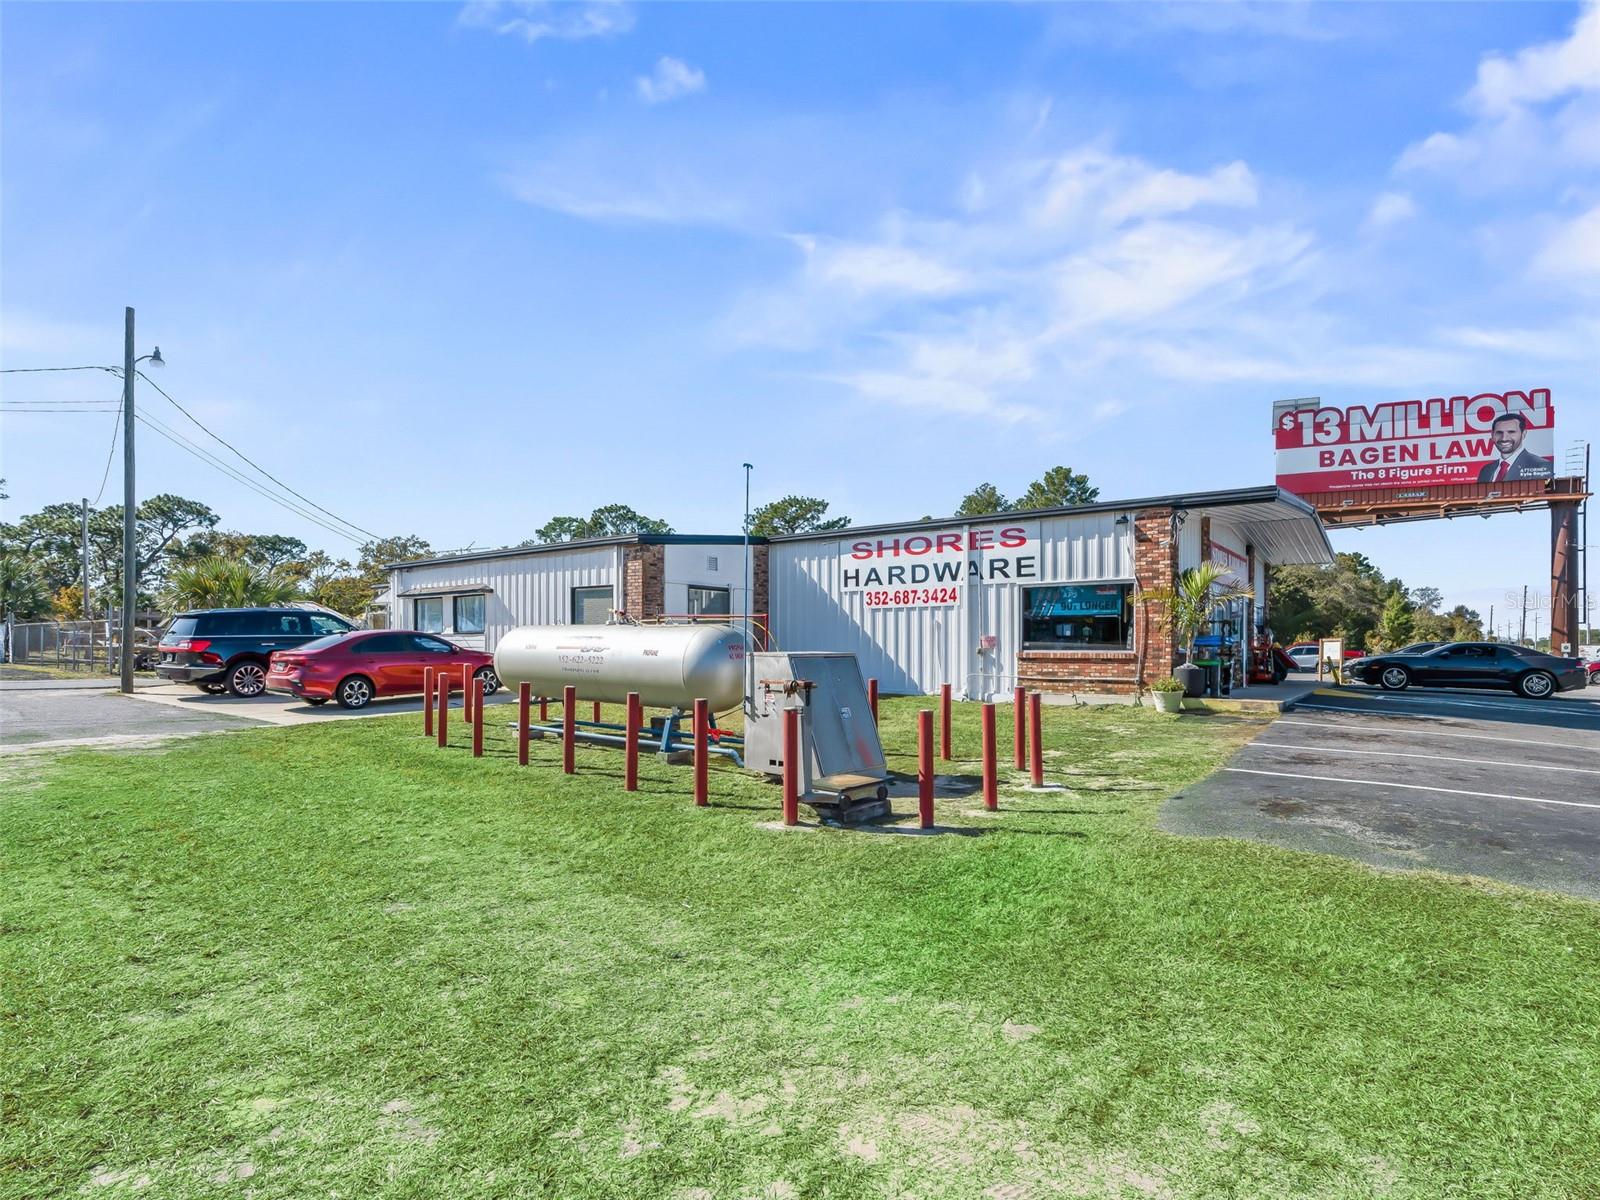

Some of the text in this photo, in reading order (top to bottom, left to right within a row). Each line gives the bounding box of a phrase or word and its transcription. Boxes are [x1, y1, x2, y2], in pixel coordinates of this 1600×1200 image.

[1281, 391, 1548, 445] $13 MILLION
[1319, 438, 1495, 468] BAGEN LAW
[1350, 464, 1468, 481] The 8 Figure Firm
[851, 527, 1027, 560] SHORES
[843, 556, 1037, 588] HARDWARE
[865, 586, 958, 606] 352-687-3424
